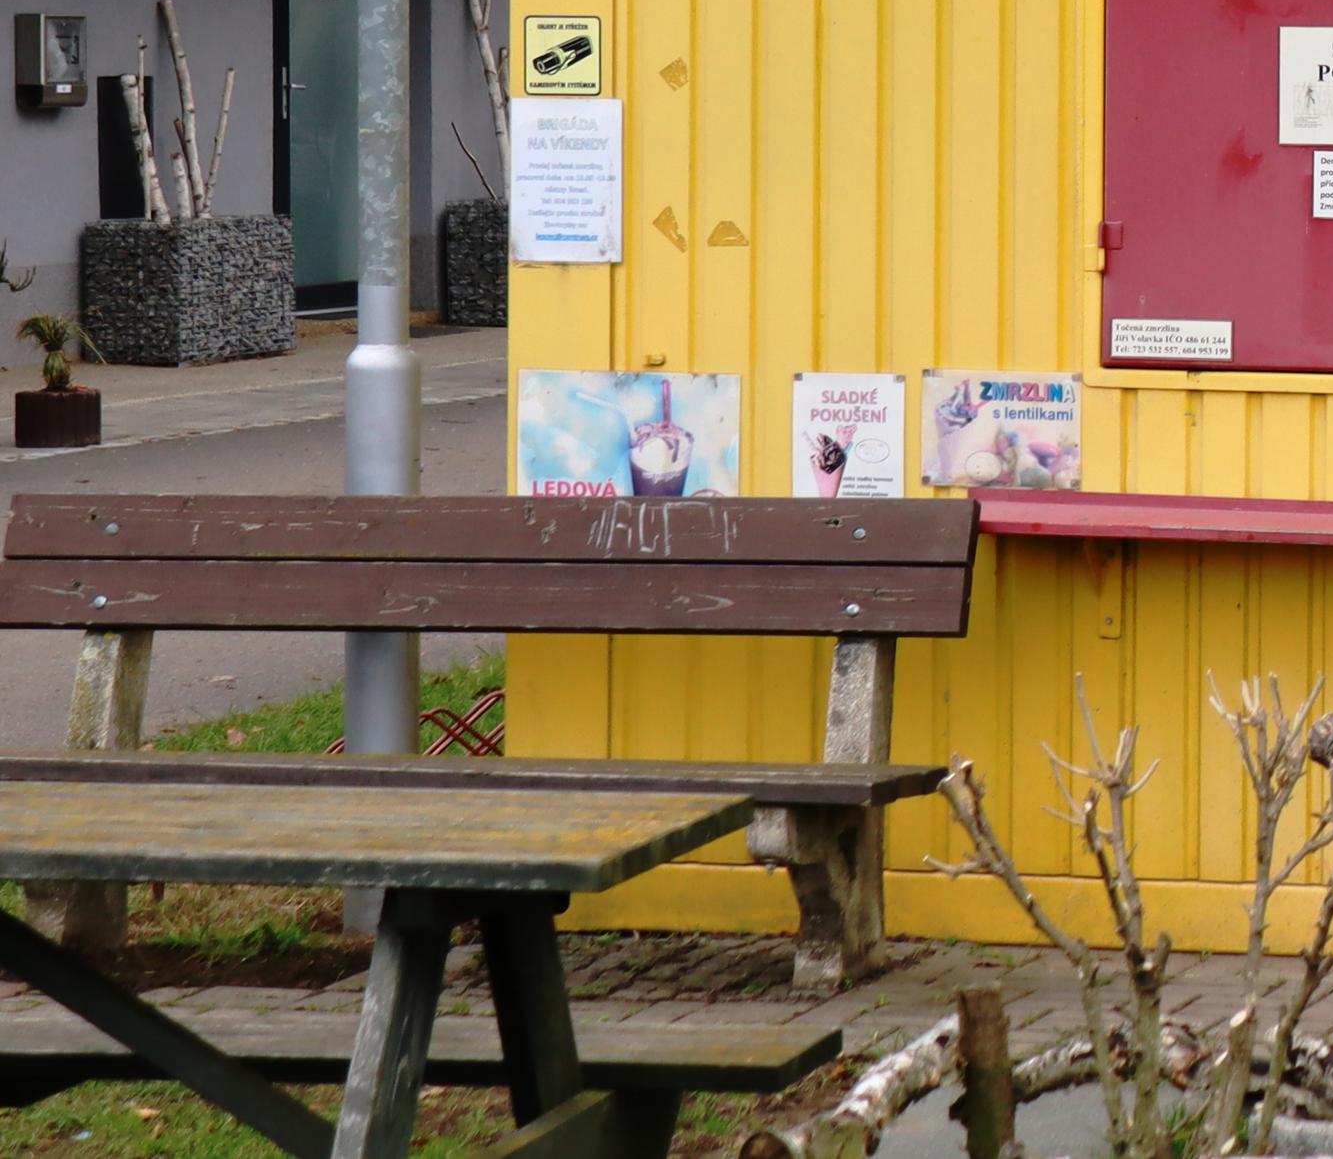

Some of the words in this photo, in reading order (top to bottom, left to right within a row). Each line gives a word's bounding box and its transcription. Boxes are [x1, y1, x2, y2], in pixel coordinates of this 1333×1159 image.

[537, 116, 599, 130] BRIGÁDA
[1115, 323, 1143, 332] Točená
[1145, 324, 1181, 332] zmrzlina
[1165, 334, 1183, 343] IČO
[1211, 337, 1226, 345] 244
[1132, 345, 1147, 353] 723
[1148, 346, 1162, 354] 532
[1198, 347, 1212, 355] 953
[1214, 347, 1229, 355] 199
[821, 388, 878, 404] SLADKÉ
[979, 381, 1076, 402] ZMRZLINA
[810, 406, 888, 423] POKUŠENÍ
[993, 411, 1001, 419] s
[1004, 407, 1074, 421] lentilkami
[532, 477, 617, 497] LEDOVÁ
